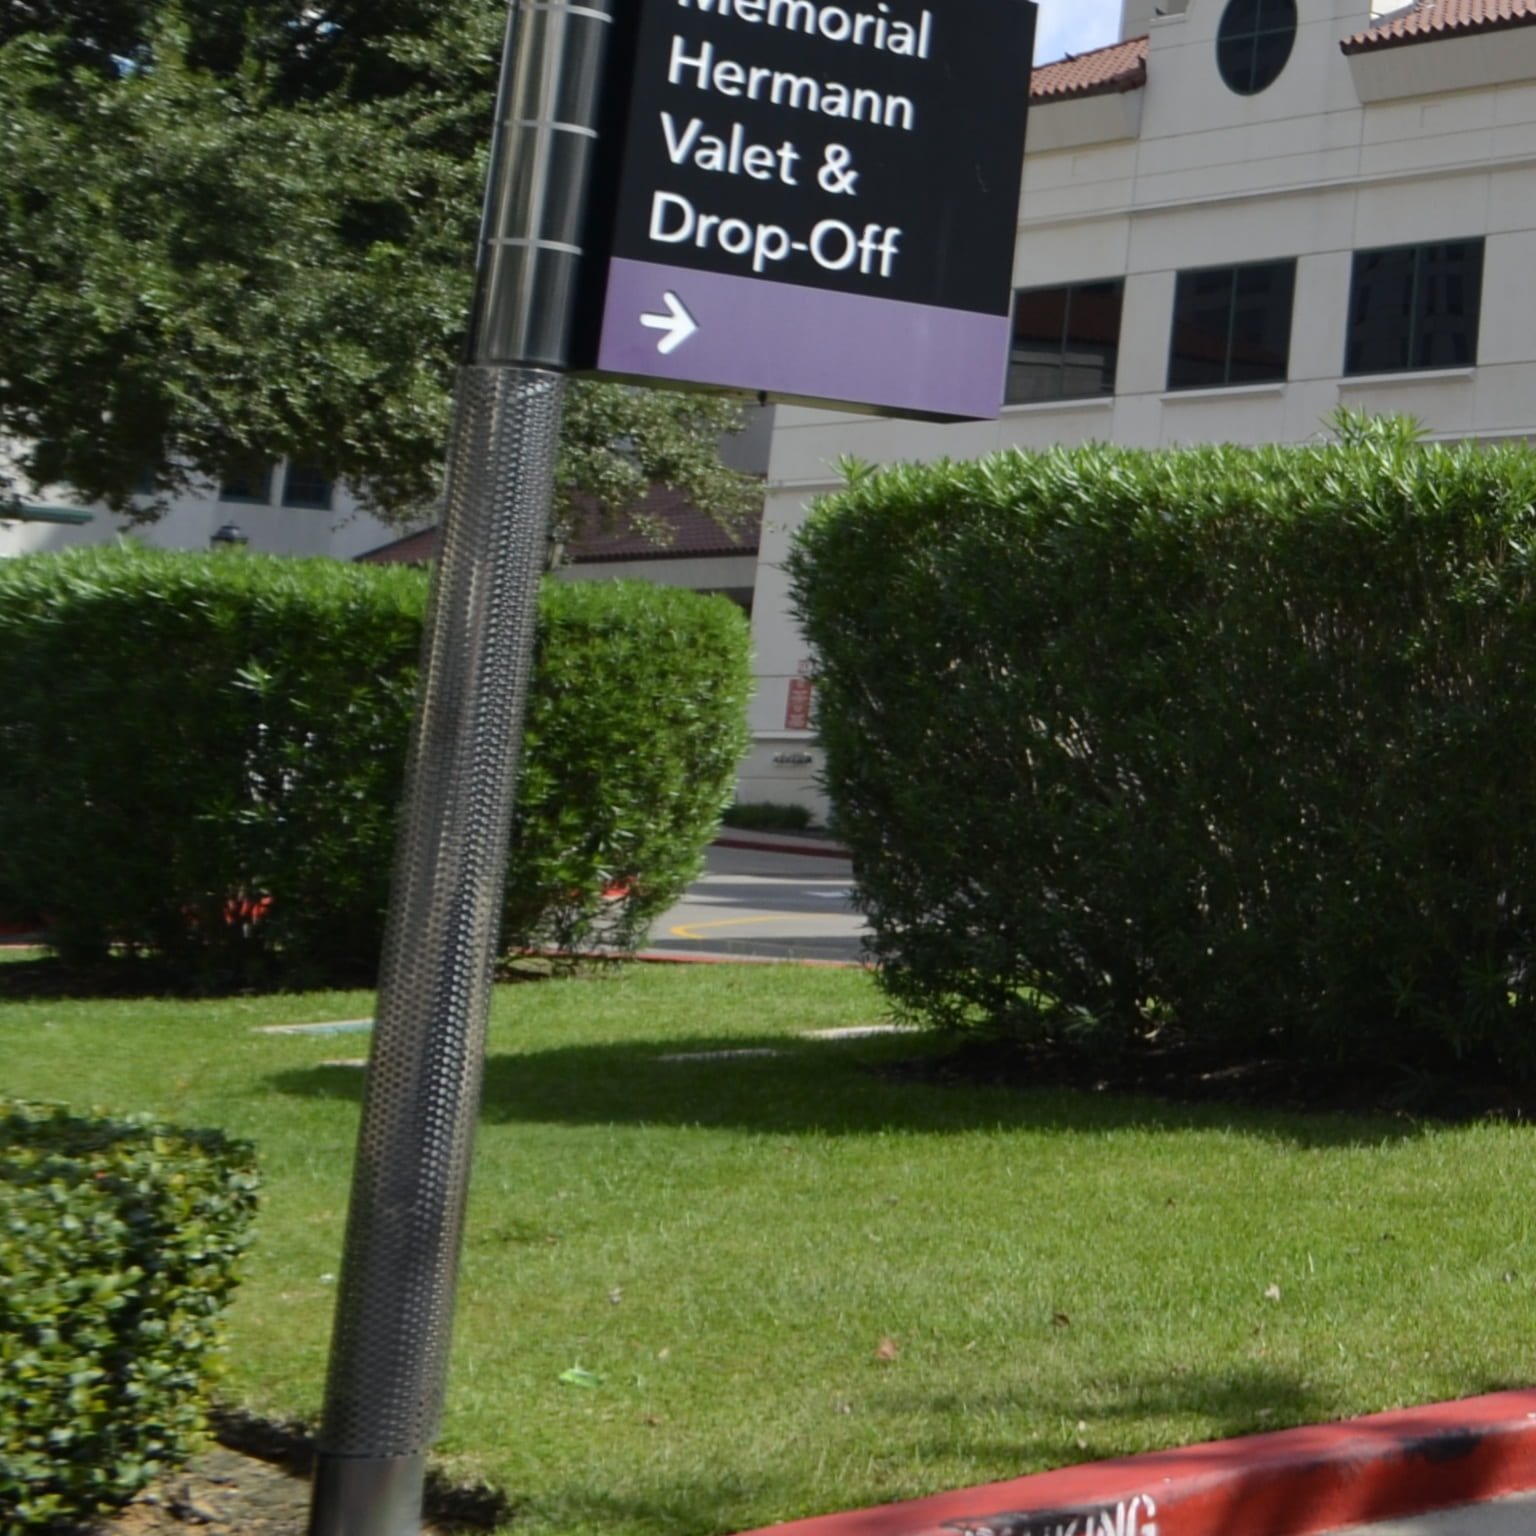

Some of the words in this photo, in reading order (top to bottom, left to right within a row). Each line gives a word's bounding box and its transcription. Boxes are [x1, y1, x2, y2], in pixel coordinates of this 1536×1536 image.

[667, 34, 915, 131] Hermann
[660, 111, 801, 186] Valet
[817, 143, 859, 196] &
[649, 190, 903, 278] Drop-Off
